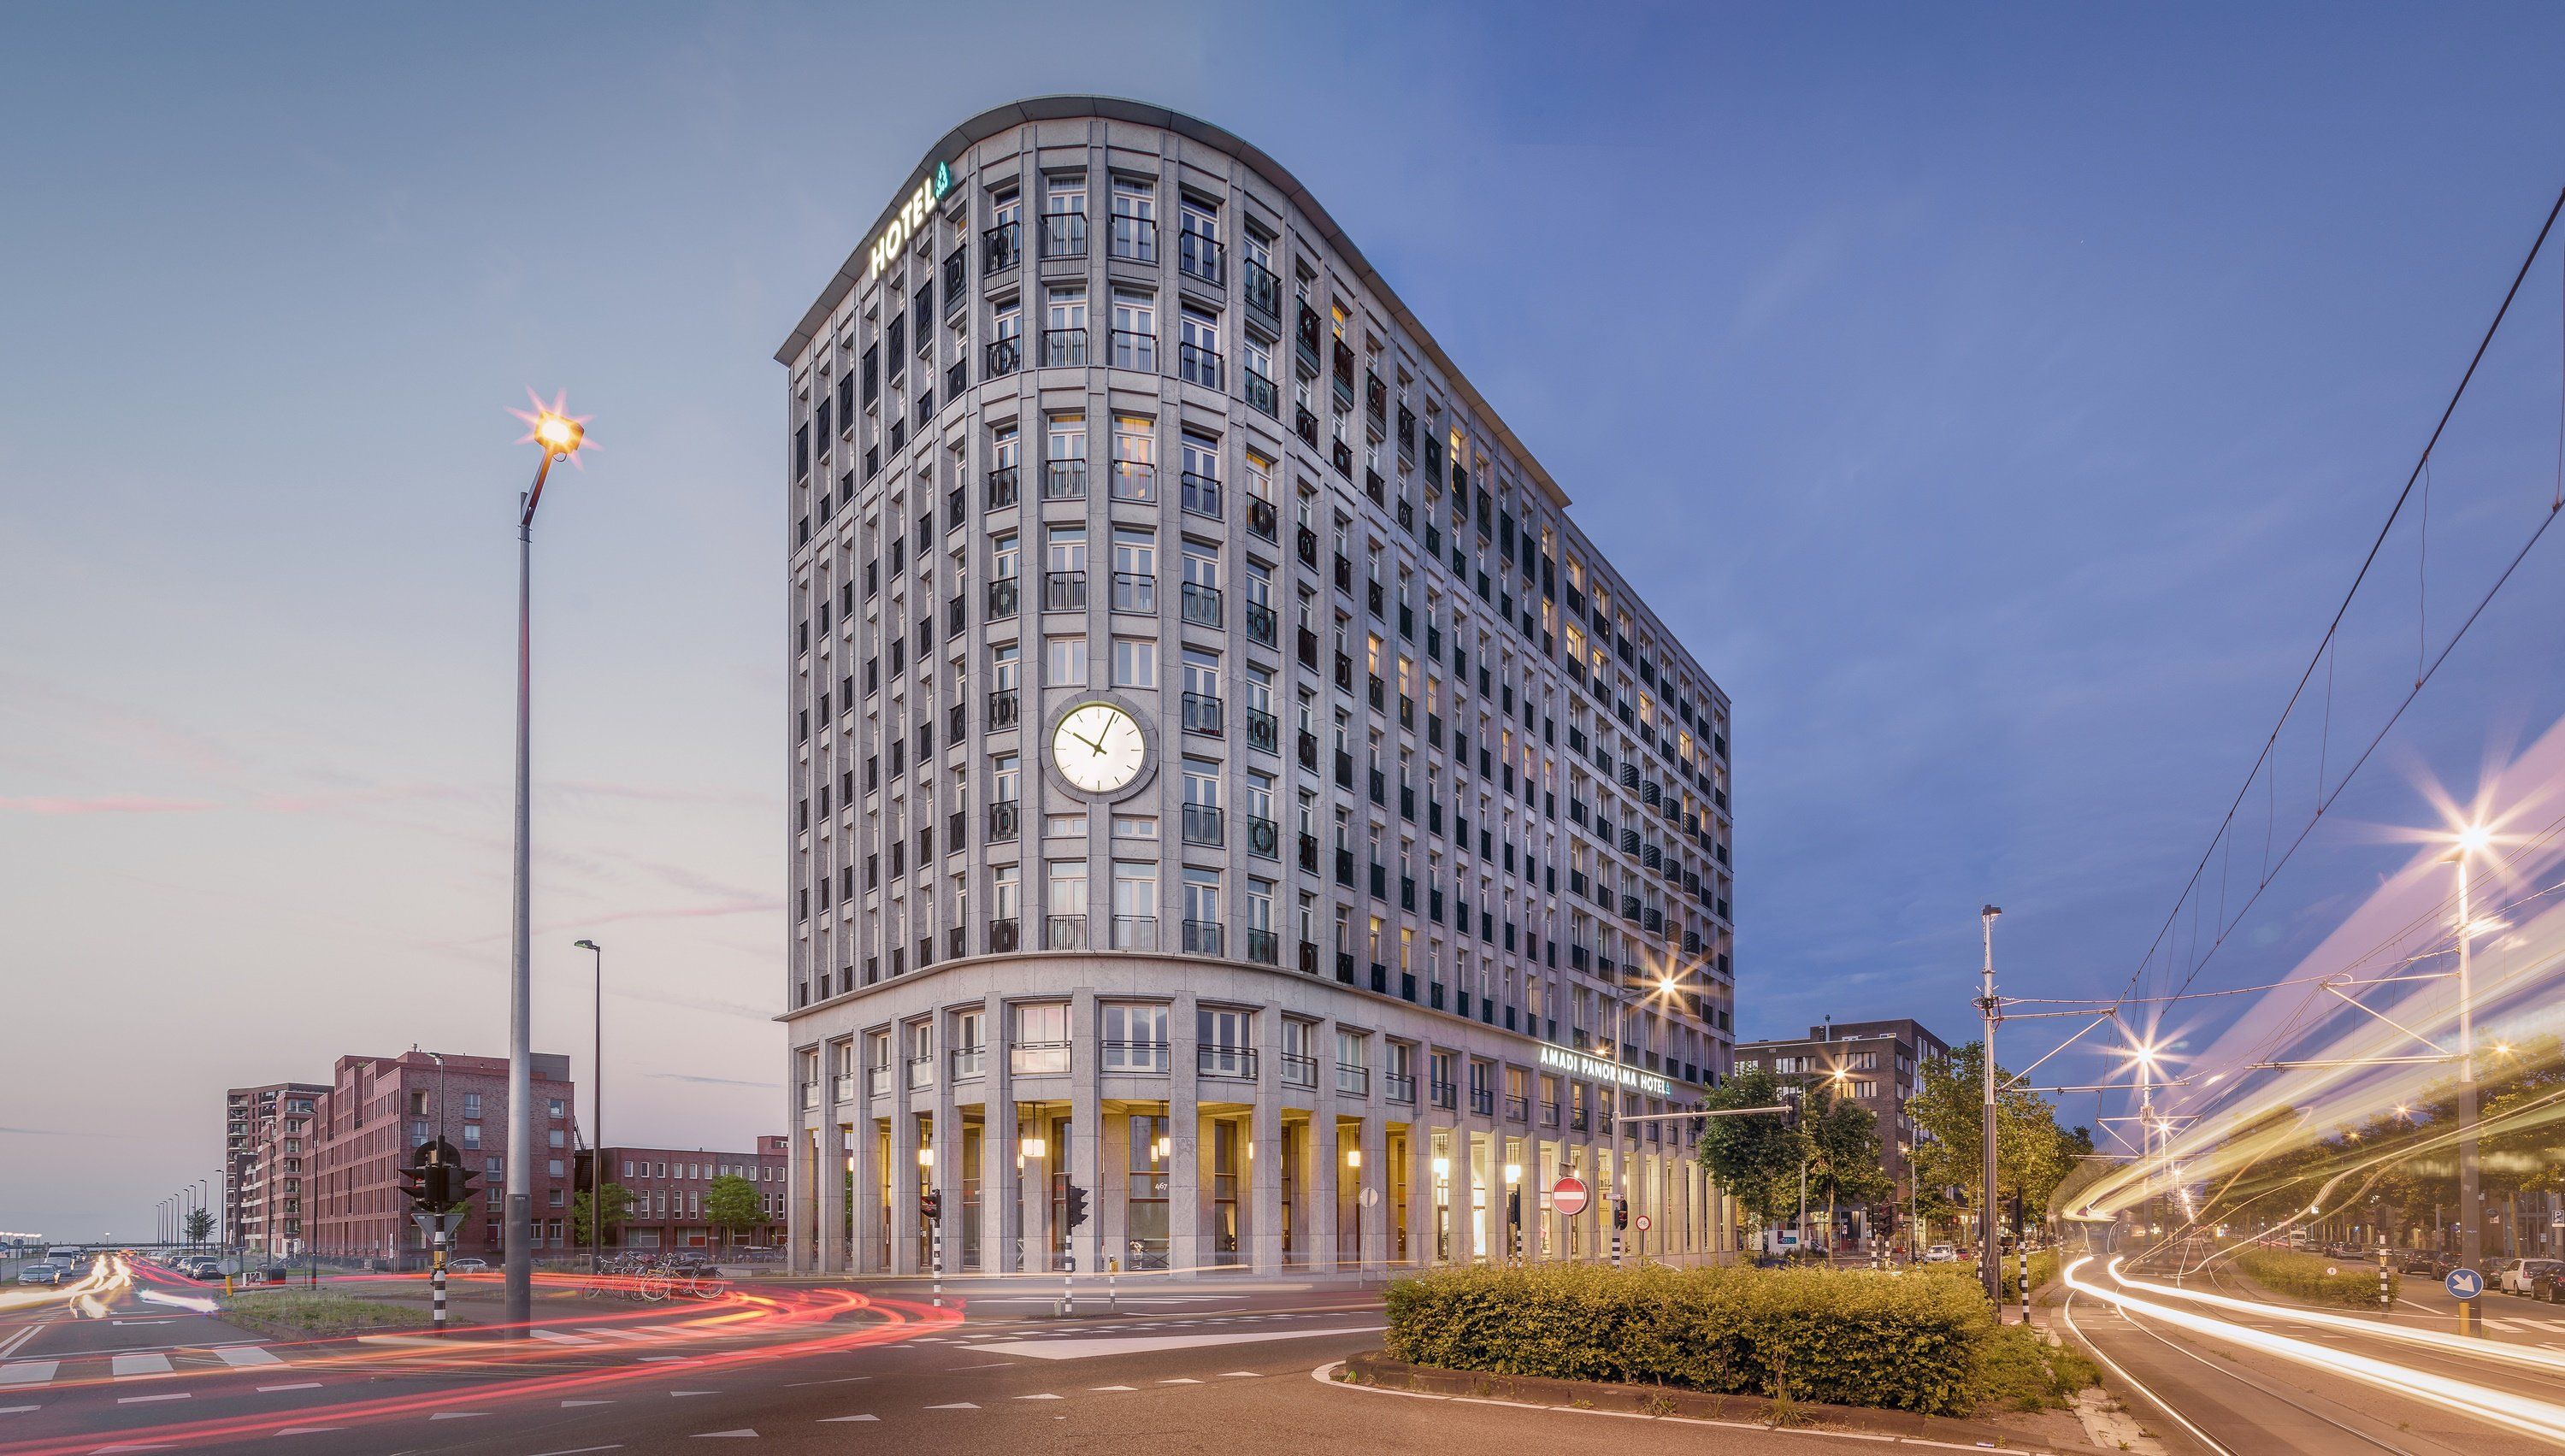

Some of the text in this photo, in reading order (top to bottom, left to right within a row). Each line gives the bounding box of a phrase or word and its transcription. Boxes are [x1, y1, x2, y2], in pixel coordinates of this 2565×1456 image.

[871, 177, 935, 280] HOTEL
[1540, 1047, 1666, 1094] AMADI PANORAMA HOTEL
